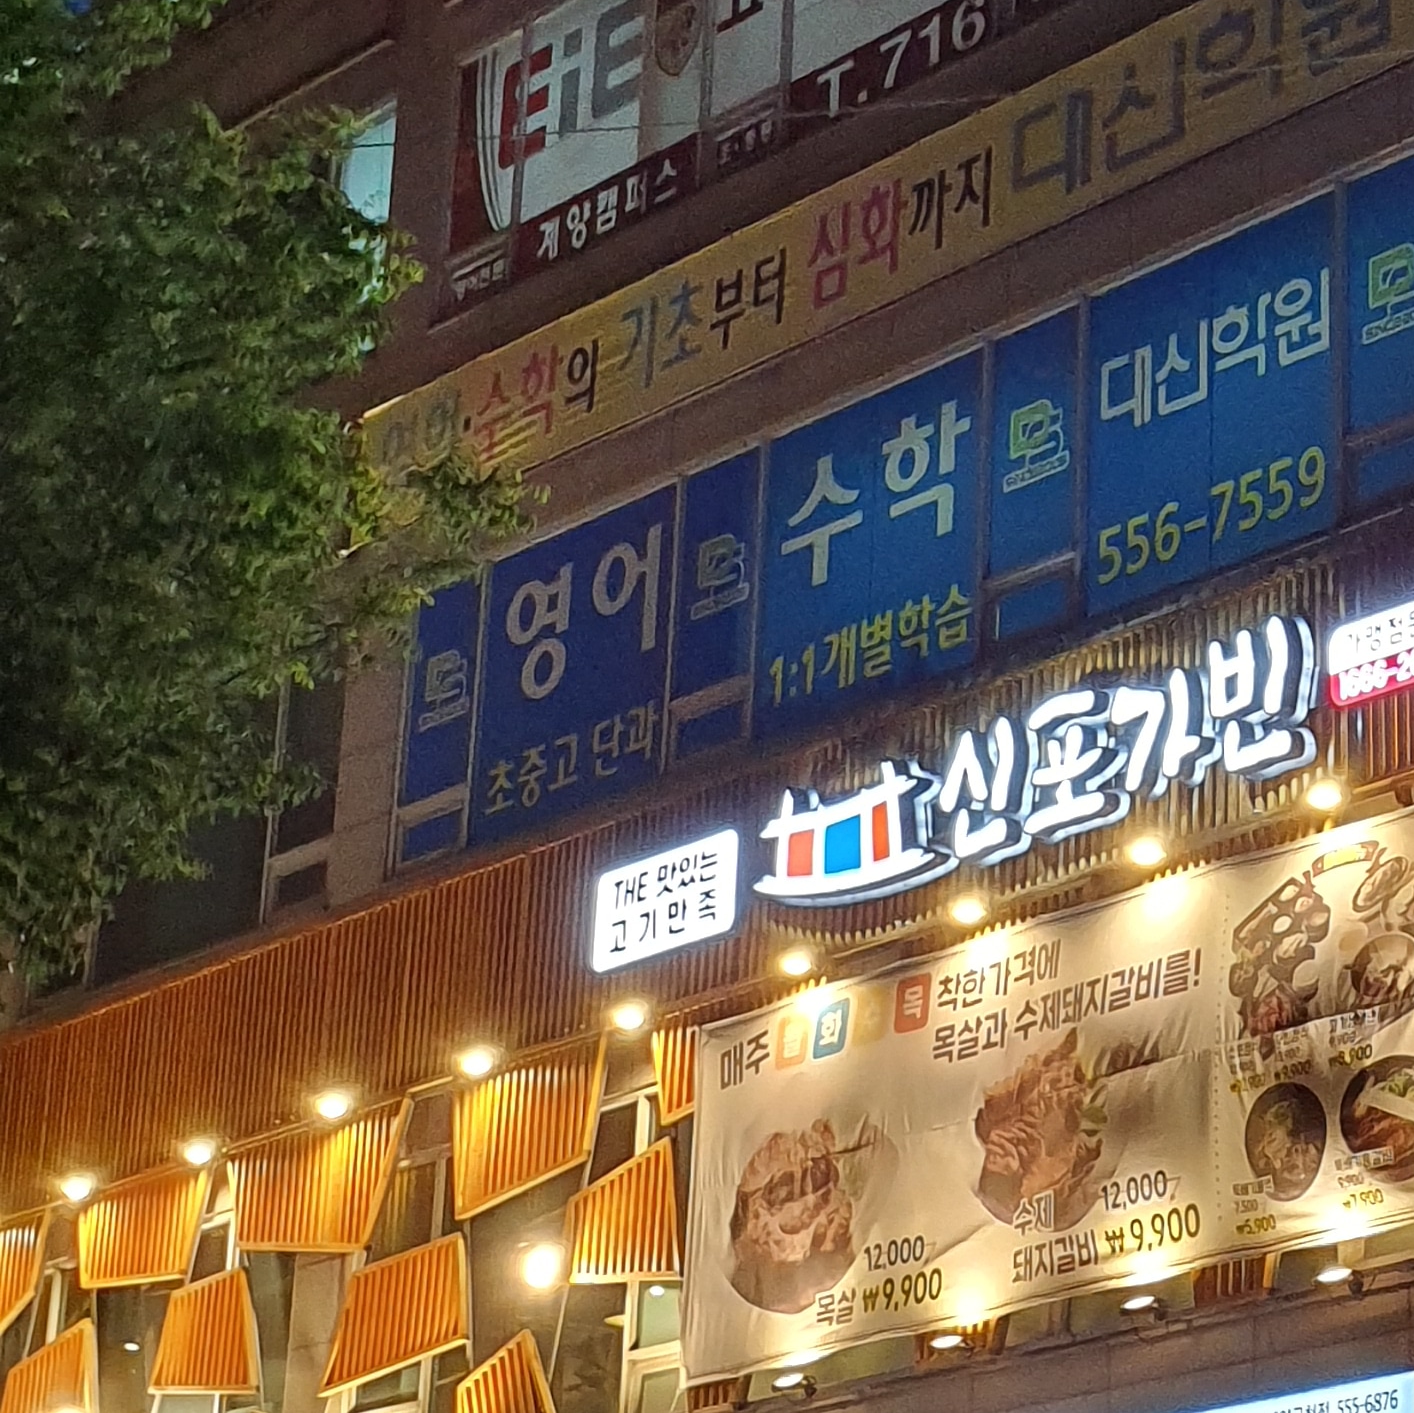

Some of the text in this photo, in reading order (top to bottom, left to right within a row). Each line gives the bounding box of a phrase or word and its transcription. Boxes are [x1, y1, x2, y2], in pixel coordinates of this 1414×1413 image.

[537, 159, 677, 260] 계양캠퍼스
[623, 247, 786, 389] 기초부터
[808, 146, 991, 309] 심화까지
[506, 267, 1330, 700] 영어 수학 대신학원
[1099, 447, 1325, 583] 556-7559
[485, 703, 659, 815] 초중고 단과
[939, 614, 1292, 858] 신포가빈
[609, 889, 717, 954] 고기만족
[614, 850, 718, 910] THE 맛있는
[719, 1030, 771, 1089] 매주
[819, 1009, 843, 1047] 화
[901, 983, 924, 1020] 목
[932, 1012, 1008, 1062] 목살과
[1013, 948, 1201, 1042] 수제돼지갈비를!
[1013, 1189, 1054, 1235] 수제
[1100, 1170, 1169, 1211] 12,000
[864, 1234, 925, 1273] 12,000
[1011, 1203, 1201, 1286] 돼지갈비 ₩9,900
[815, 1267, 942, 1327] 목살 ₩9,900
[1337, 1389, 1398, 1413] 555-6876
